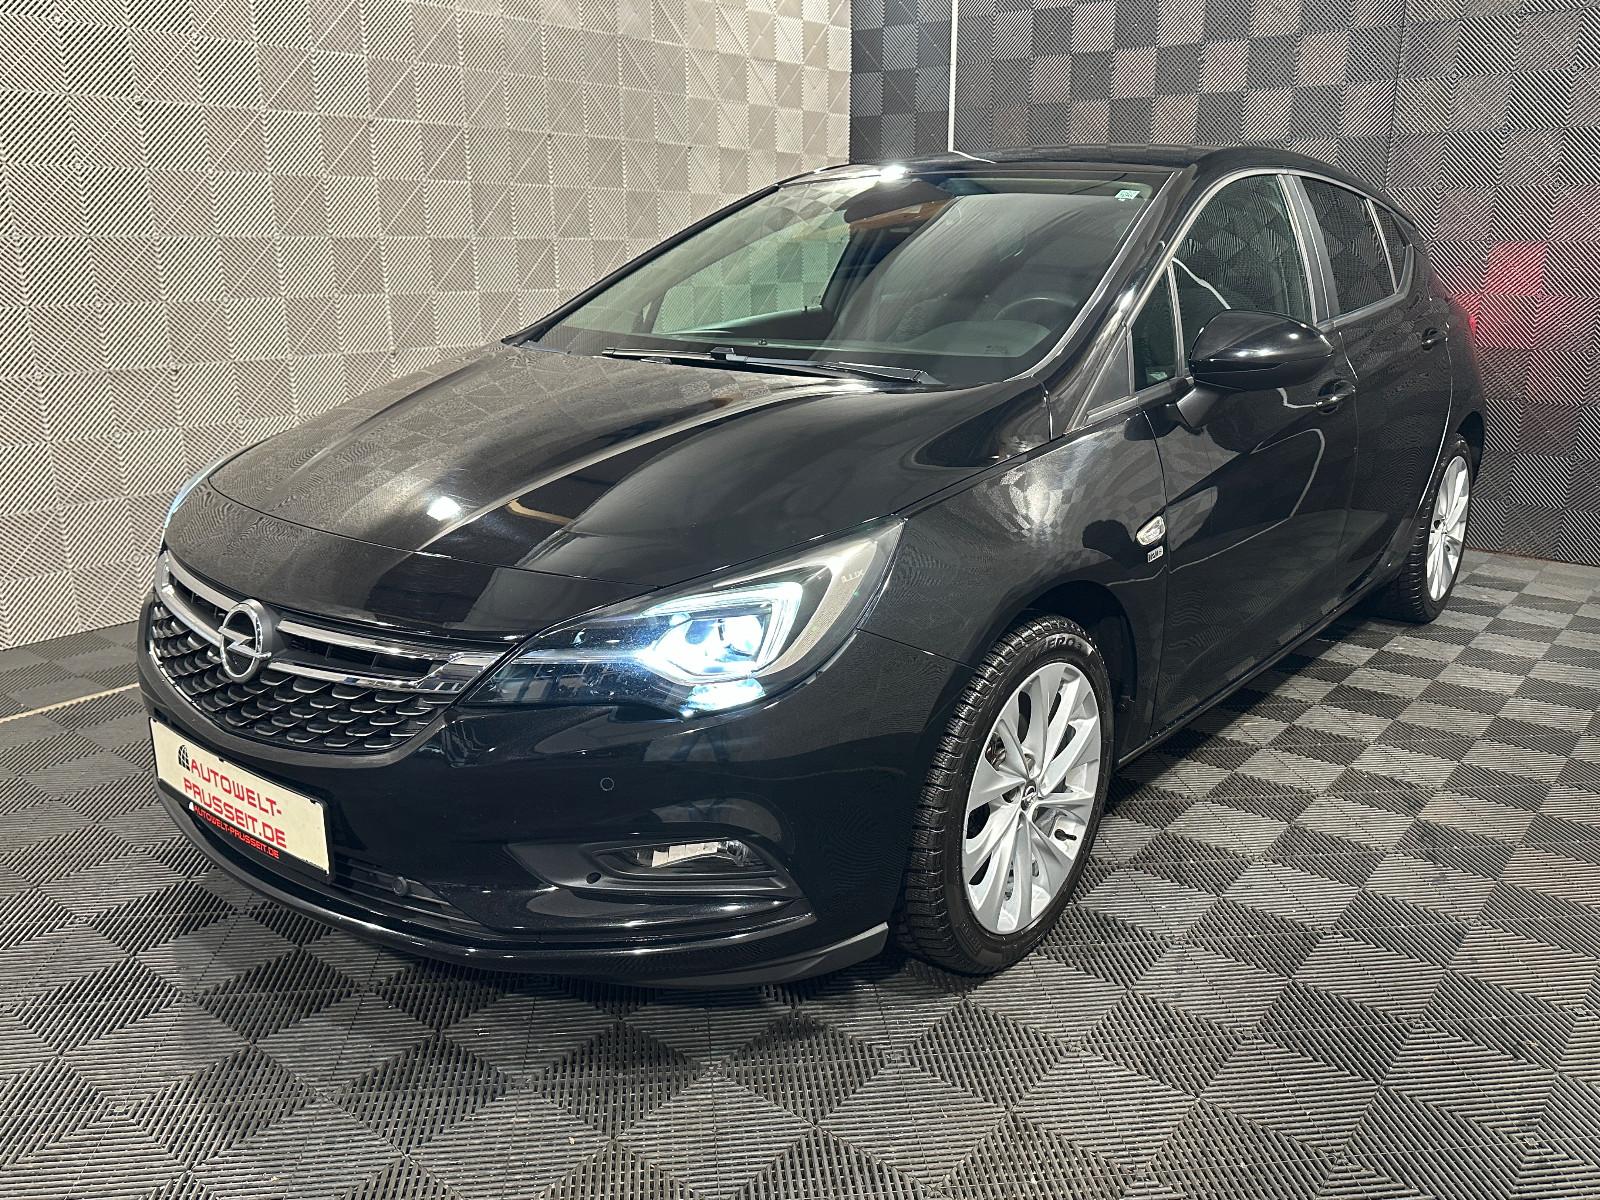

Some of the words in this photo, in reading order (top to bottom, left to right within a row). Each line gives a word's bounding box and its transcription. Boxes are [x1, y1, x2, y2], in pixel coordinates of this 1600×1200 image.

[184, 778, 287, 848] PRUSSEIT.DE
[191, 760, 282, 816] AUTOWELT-
[194, 805, 280, 859] AUTOWELT-PRUSSEIT.DE
